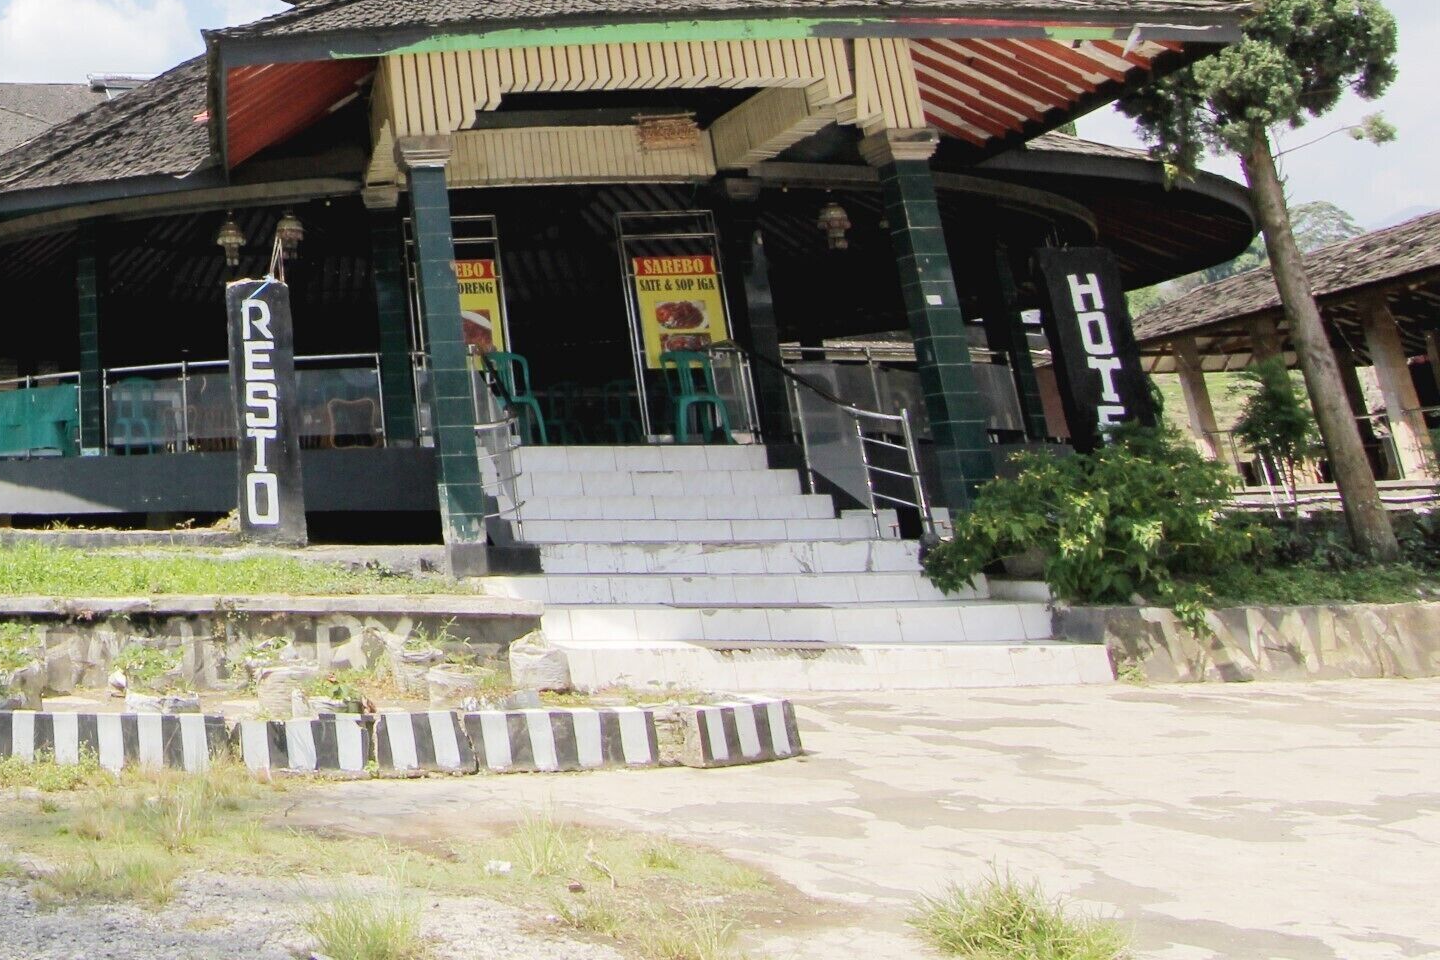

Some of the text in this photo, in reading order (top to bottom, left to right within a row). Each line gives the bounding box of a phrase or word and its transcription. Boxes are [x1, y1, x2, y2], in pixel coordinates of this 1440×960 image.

[644, 258, 704, 274] SAREBO
[639, 277, 715, 291] SATE & SOP IGA
[241, 298, 280, 525] RESTO
